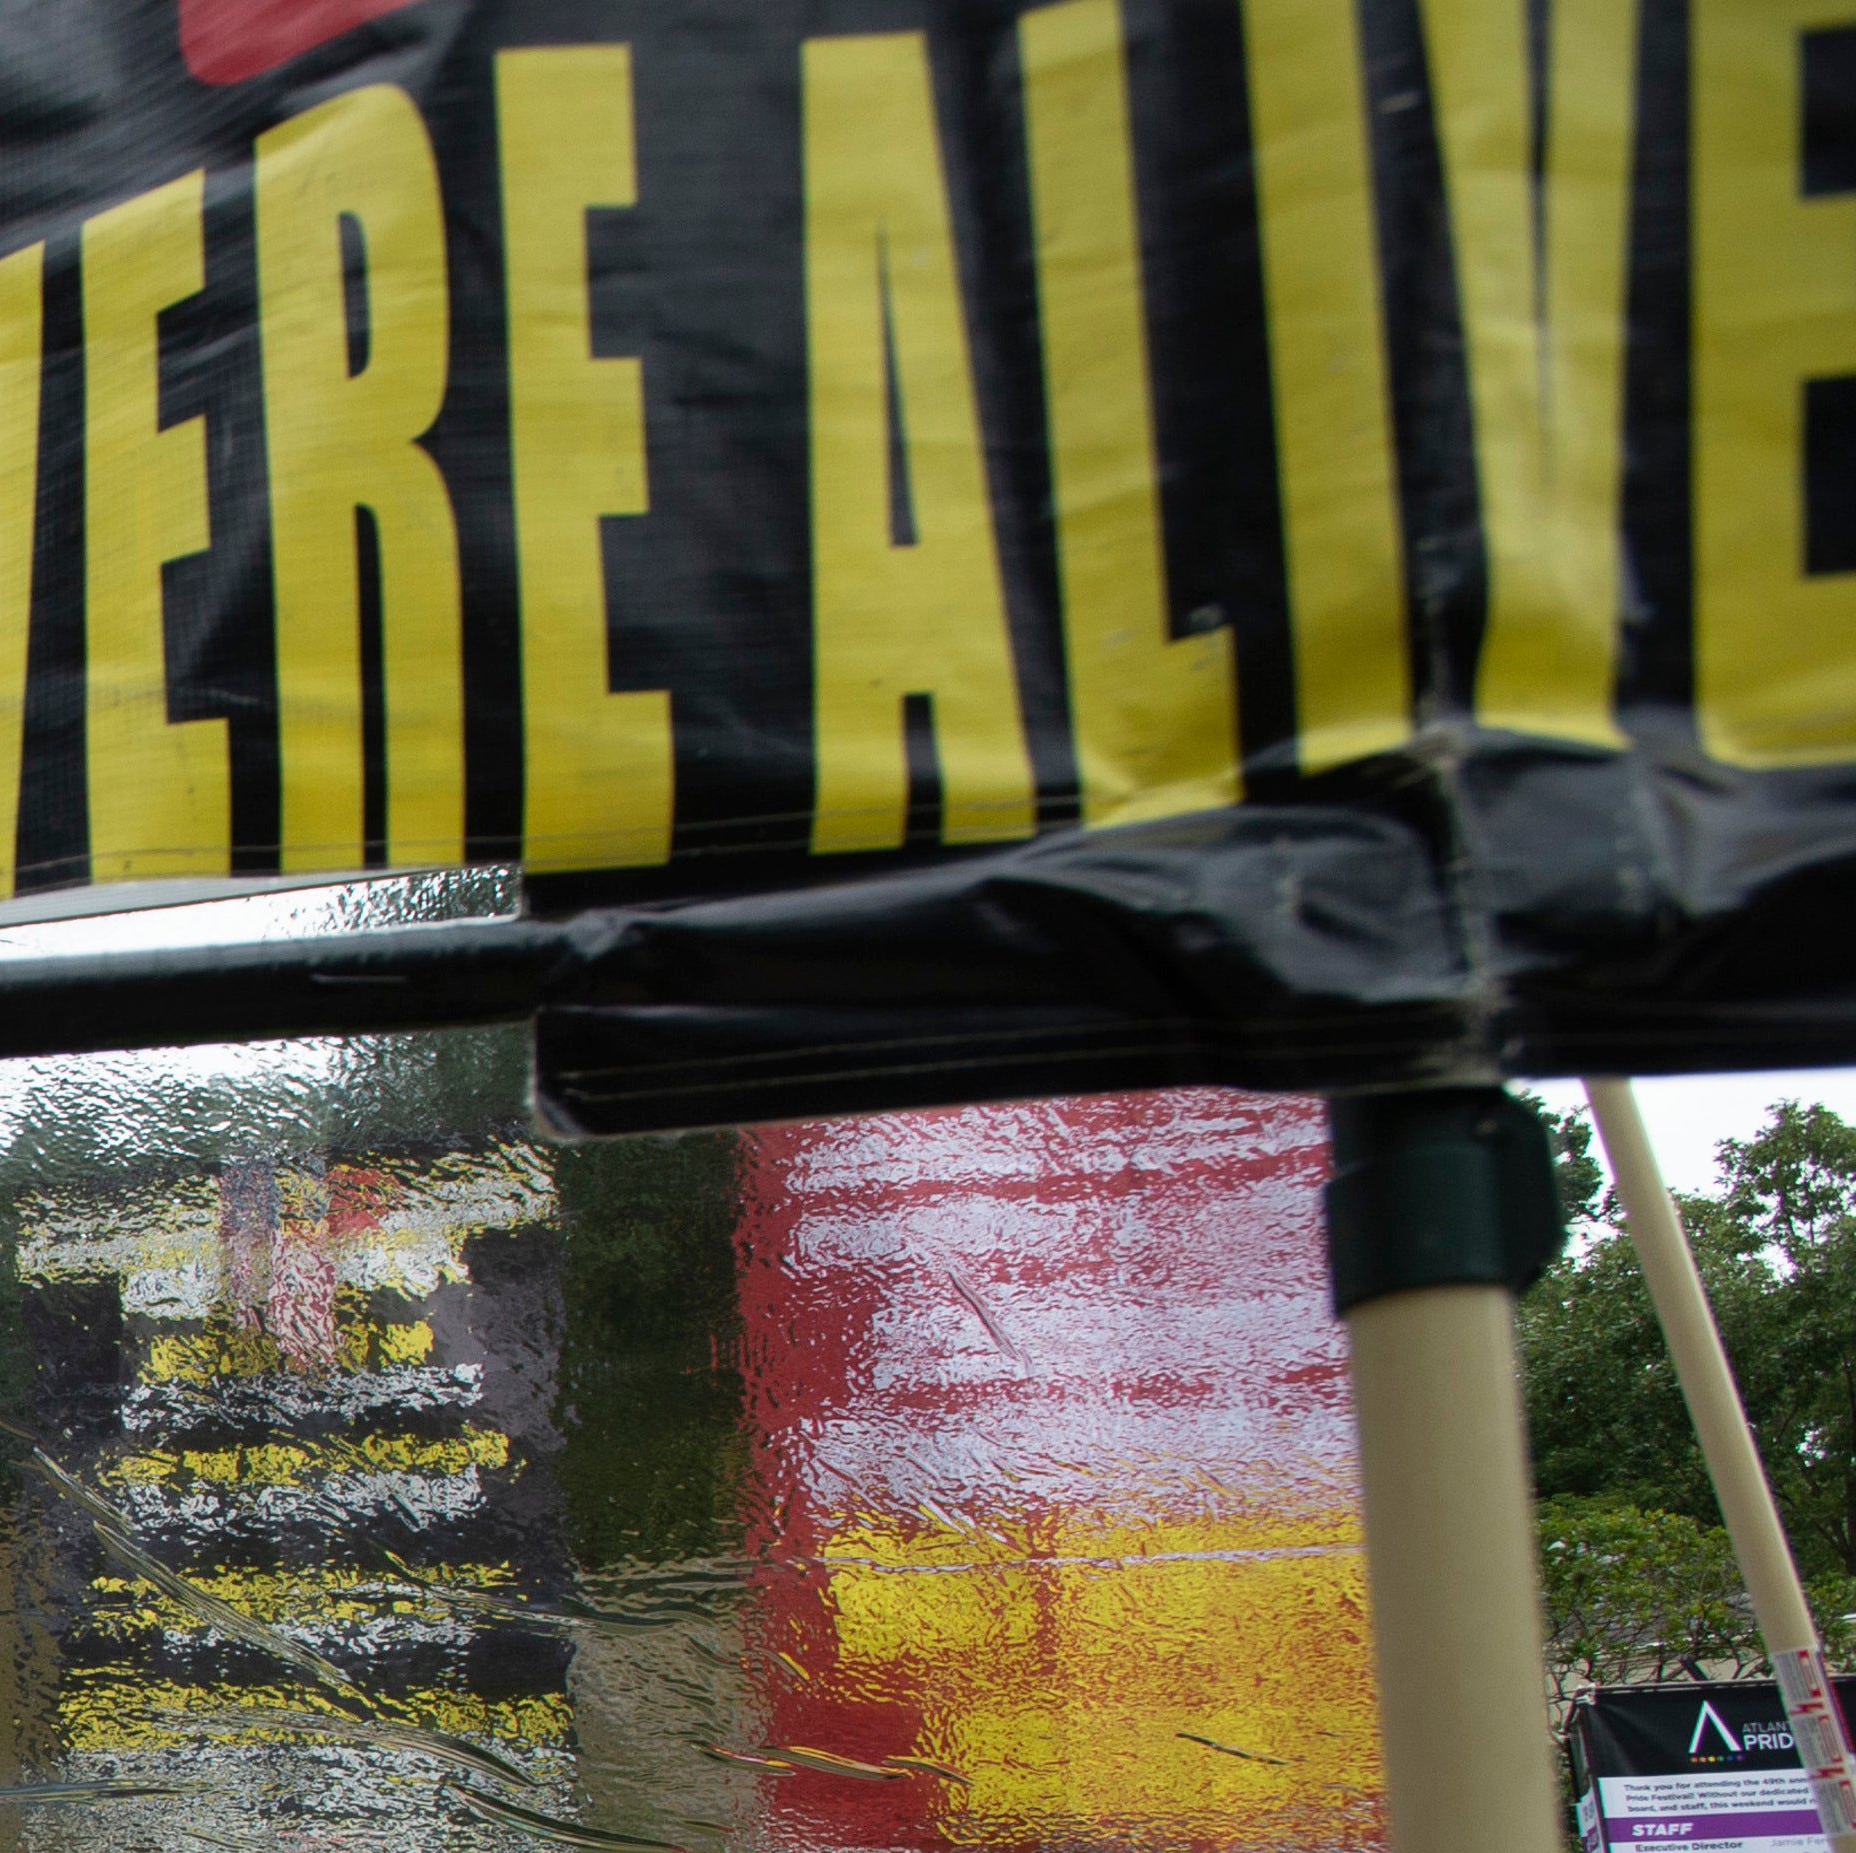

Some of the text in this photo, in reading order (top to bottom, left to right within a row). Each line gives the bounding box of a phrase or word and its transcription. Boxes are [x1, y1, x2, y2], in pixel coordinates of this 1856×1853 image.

[801, 0, 1856, 855] ALIVE
[1742, 1720, 1792, 1733] ATLAN
[1743, 1733, 1795, 1750] PRID
[1632, 1822, 1694, 1837] STAFF
[1634, 1840, 1744, 1852] Executive Director
